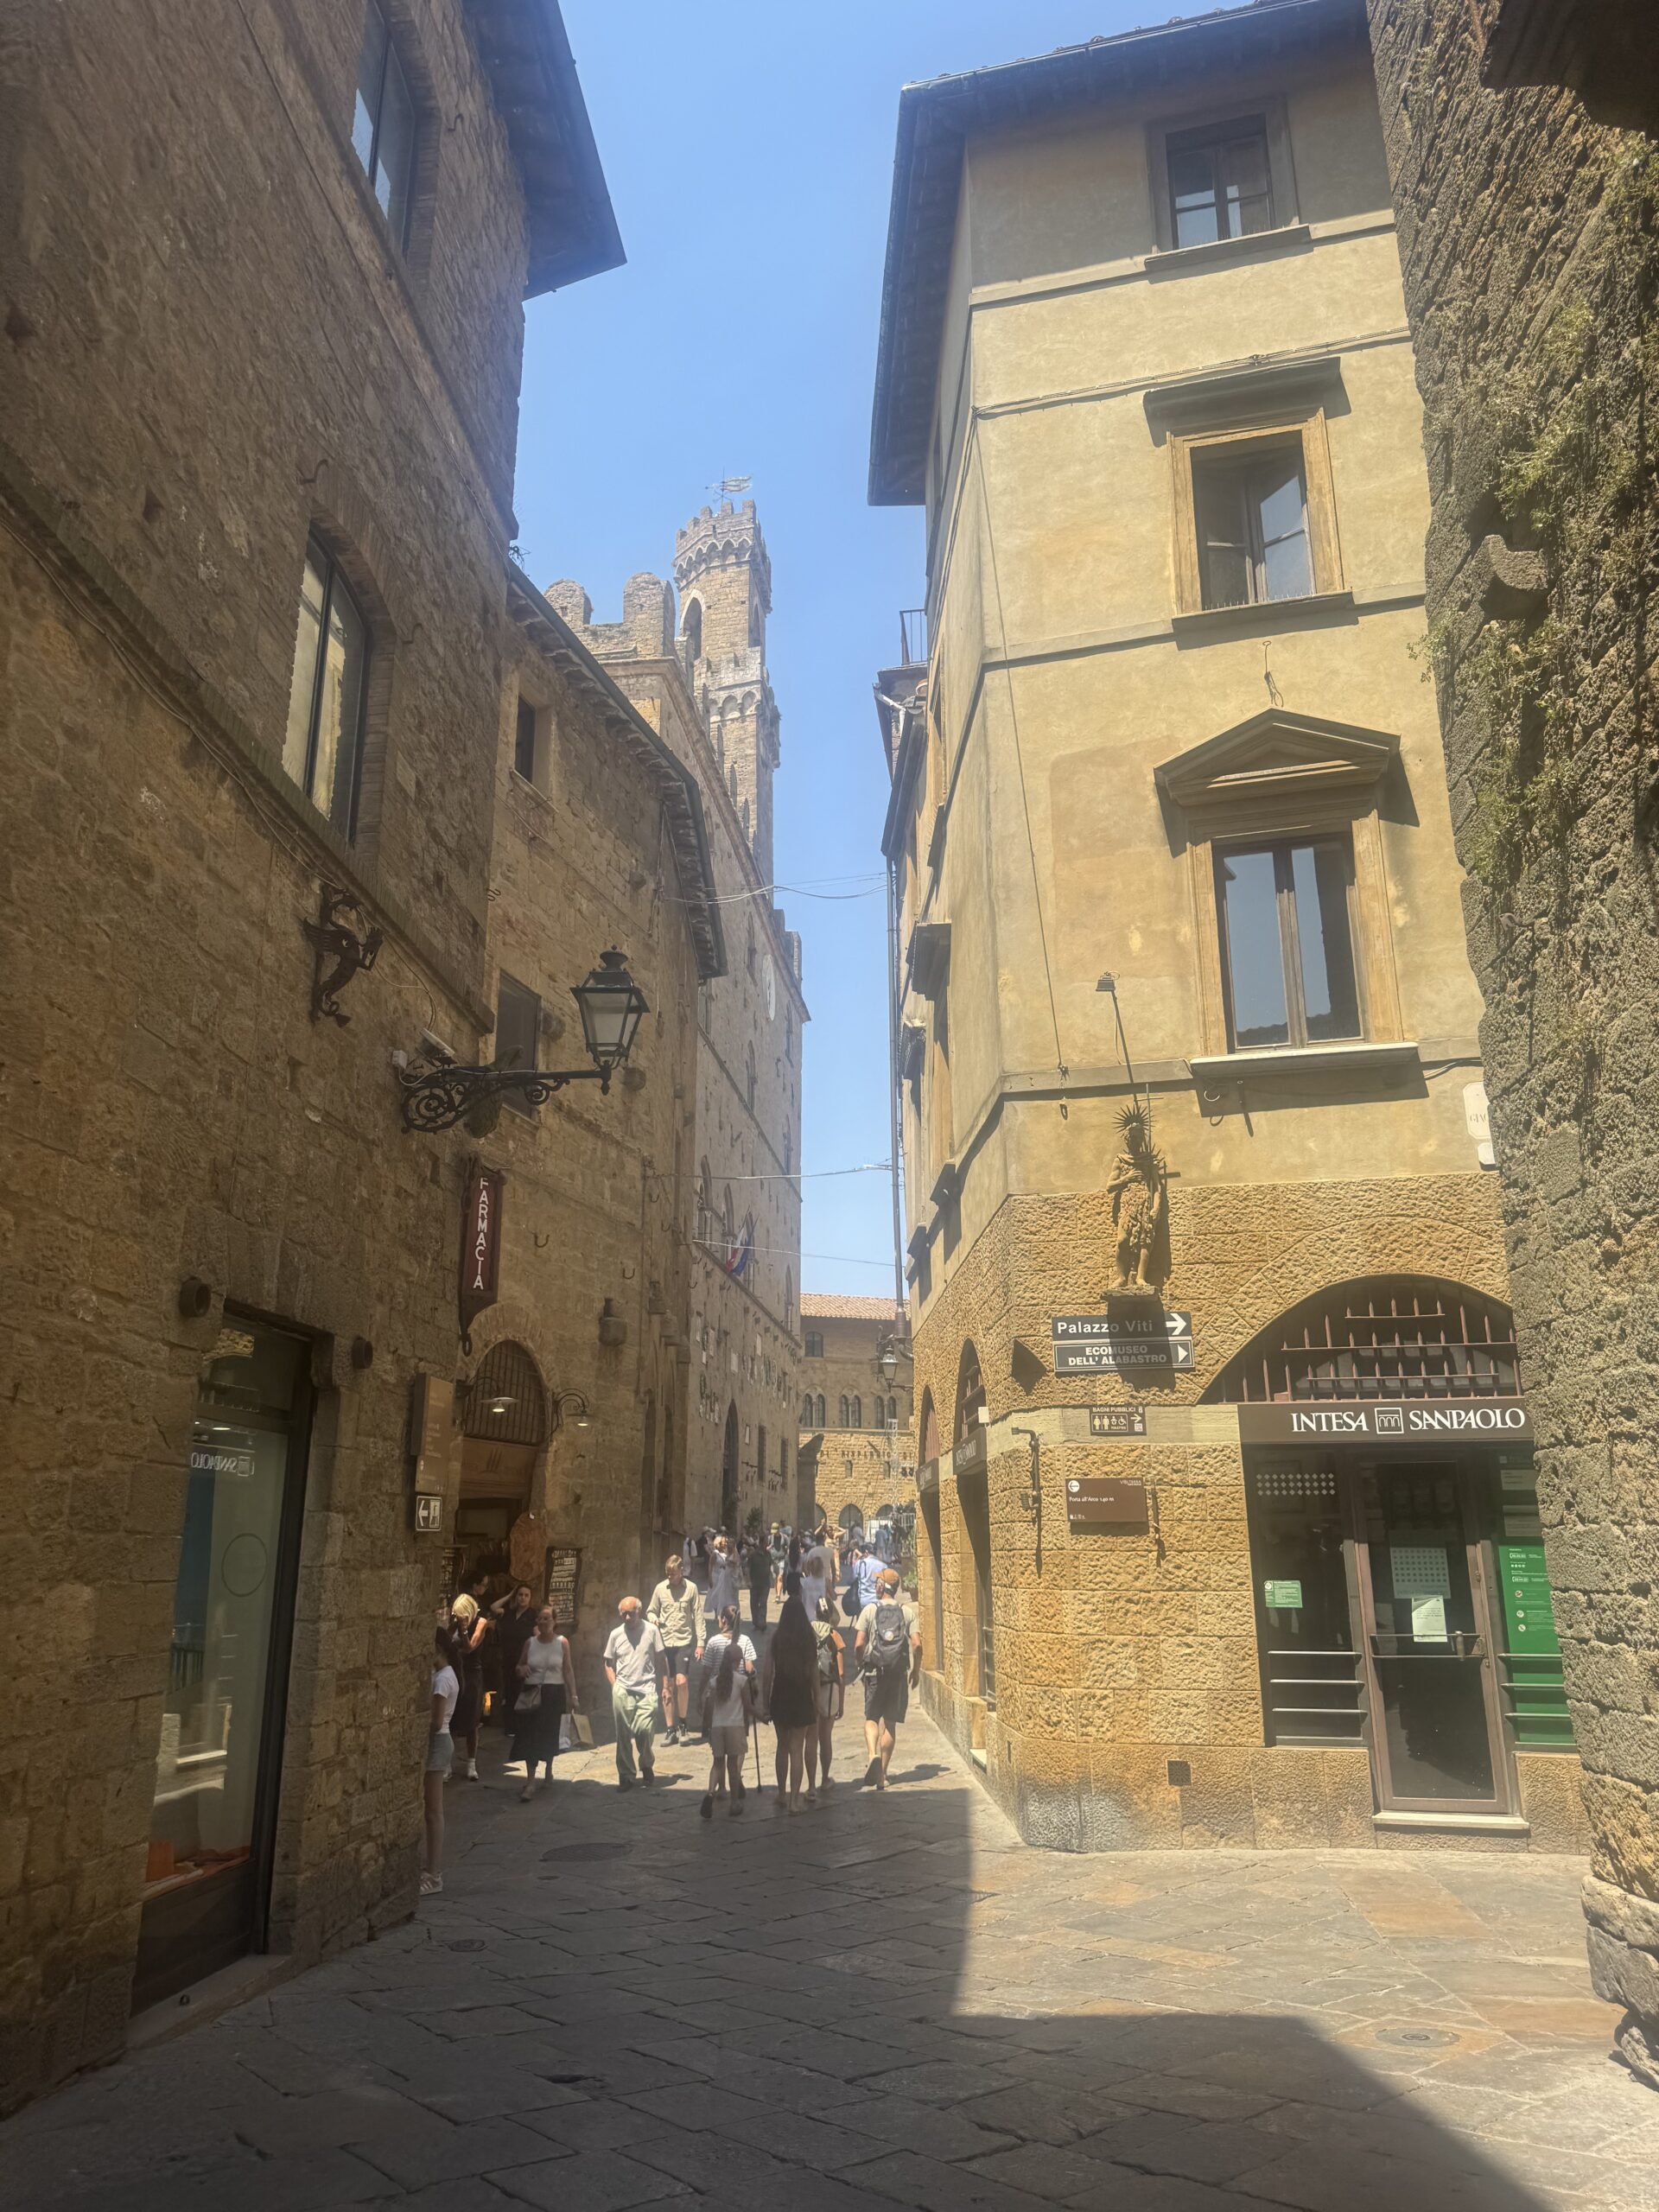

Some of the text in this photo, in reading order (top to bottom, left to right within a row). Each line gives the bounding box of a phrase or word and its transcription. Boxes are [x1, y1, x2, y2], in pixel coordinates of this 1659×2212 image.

[473, 1177, 489, 1290] FARMACIA
[1058, 1320, 1154, 1334] Palazzo Viti
[1085, 1344, 1148, 1356] ECOMUSEO
[1068, 1354, 1166, 1366] DELL' ALABASTRO
[1291, 1408, 1526, 1433] INTESA SANPAOLO
